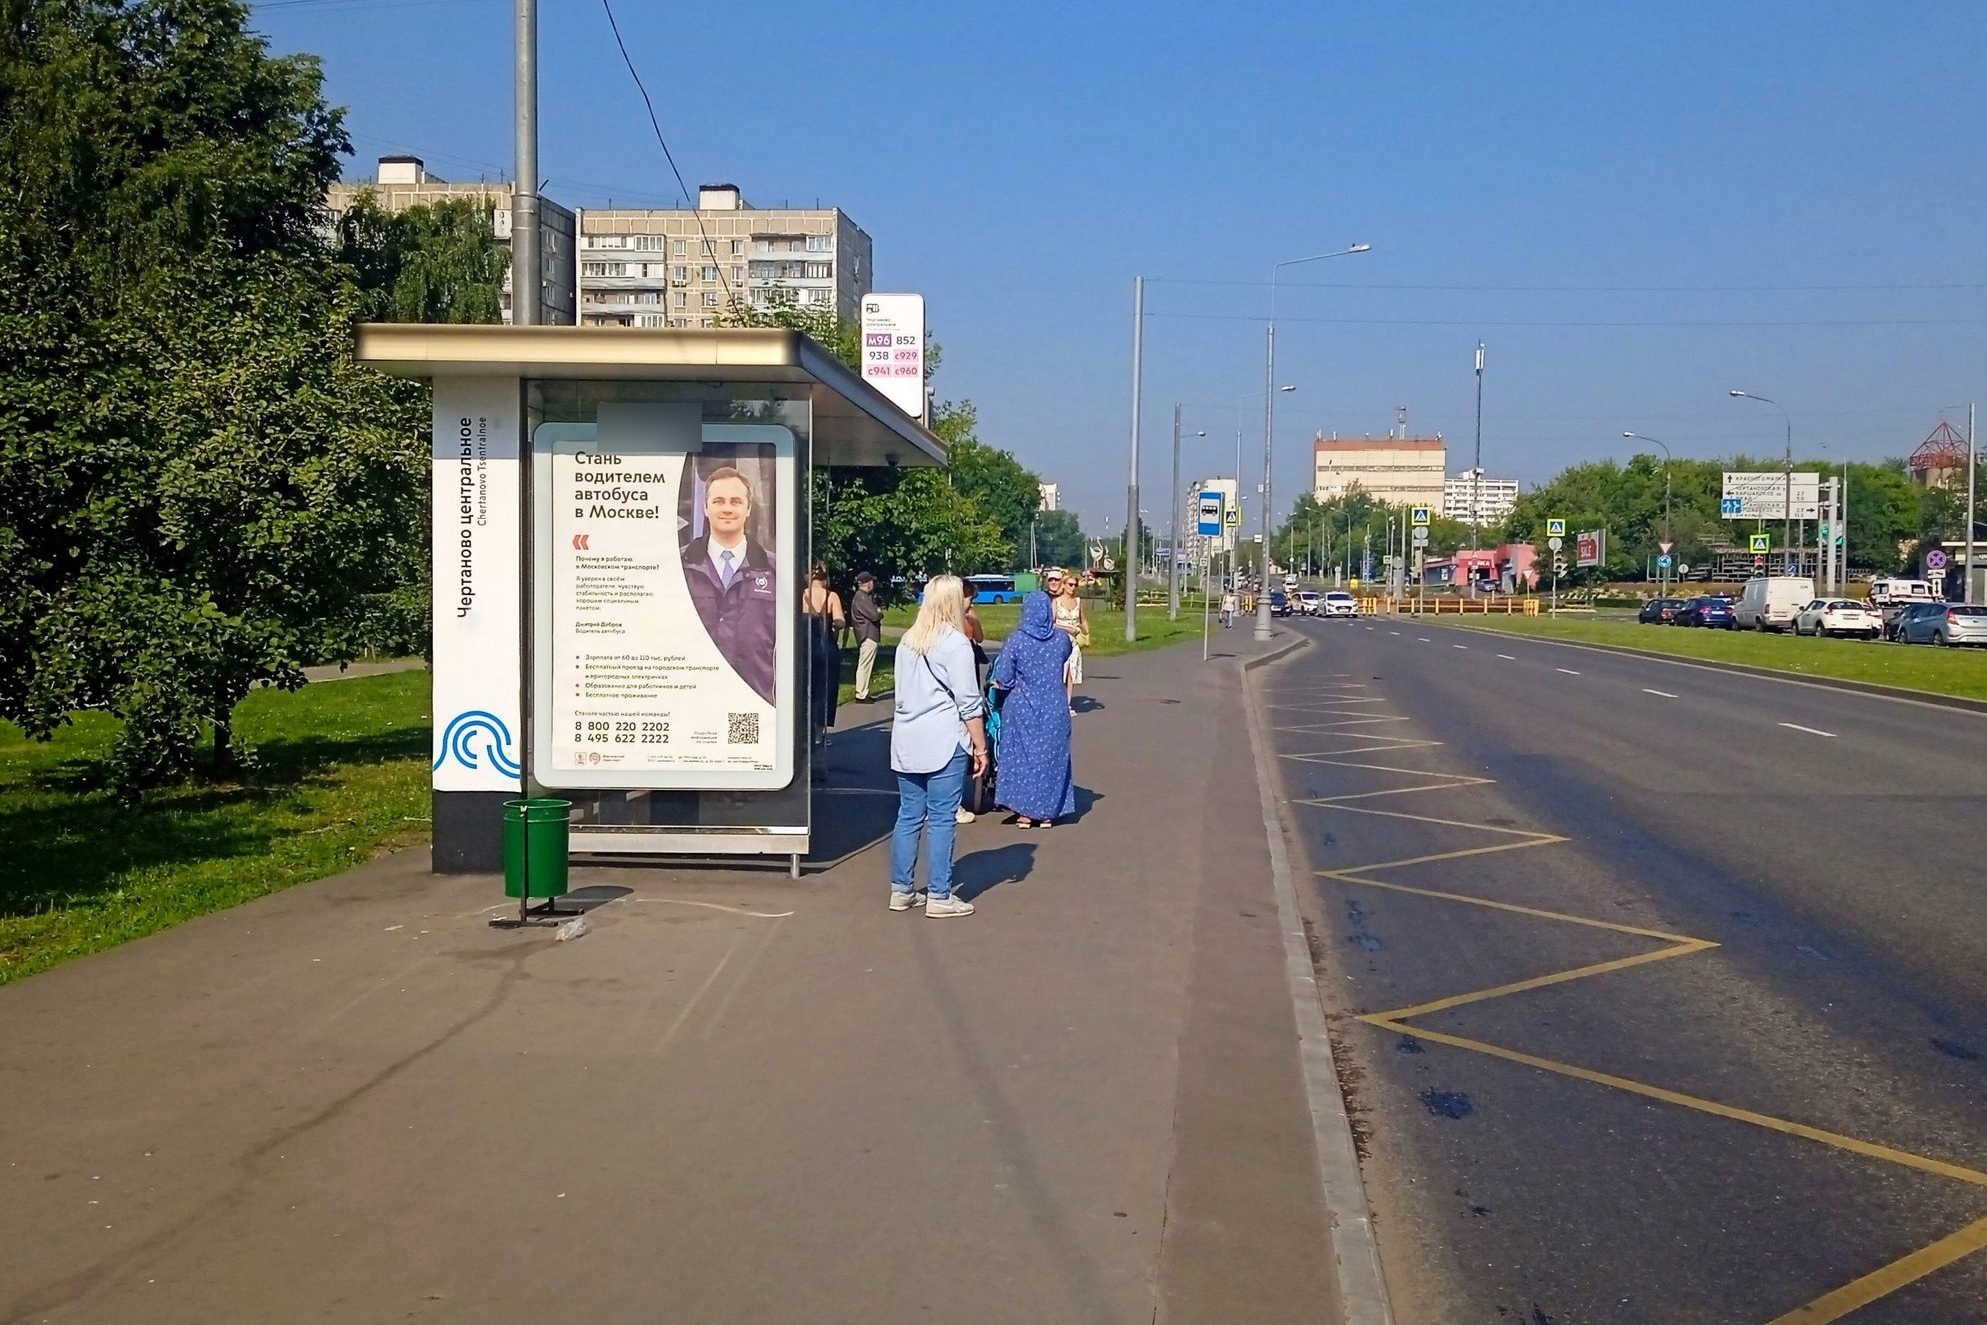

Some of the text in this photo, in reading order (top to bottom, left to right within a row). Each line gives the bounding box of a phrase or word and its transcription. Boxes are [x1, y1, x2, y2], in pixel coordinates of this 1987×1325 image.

[896, 336, 916, 345] 852
[869, 351, 917, 360] 938 с929
[868, 366, 918, 376] с941 с960
[575, 450, 622, 465] Стань
[476, 416, 487, 526] Chertanovo Tsentralnoe
[574, 472, 666, 485] водителем
[574, 487, 649, 504] автобуса
[457, 417, 476, 618] Чертаново центральное
[575, 504, 660, 519] в Москве!
[574, 721, 670, 732] 8 800 220 2202
[574, 733, 670, 744] 8 495 622 2222
